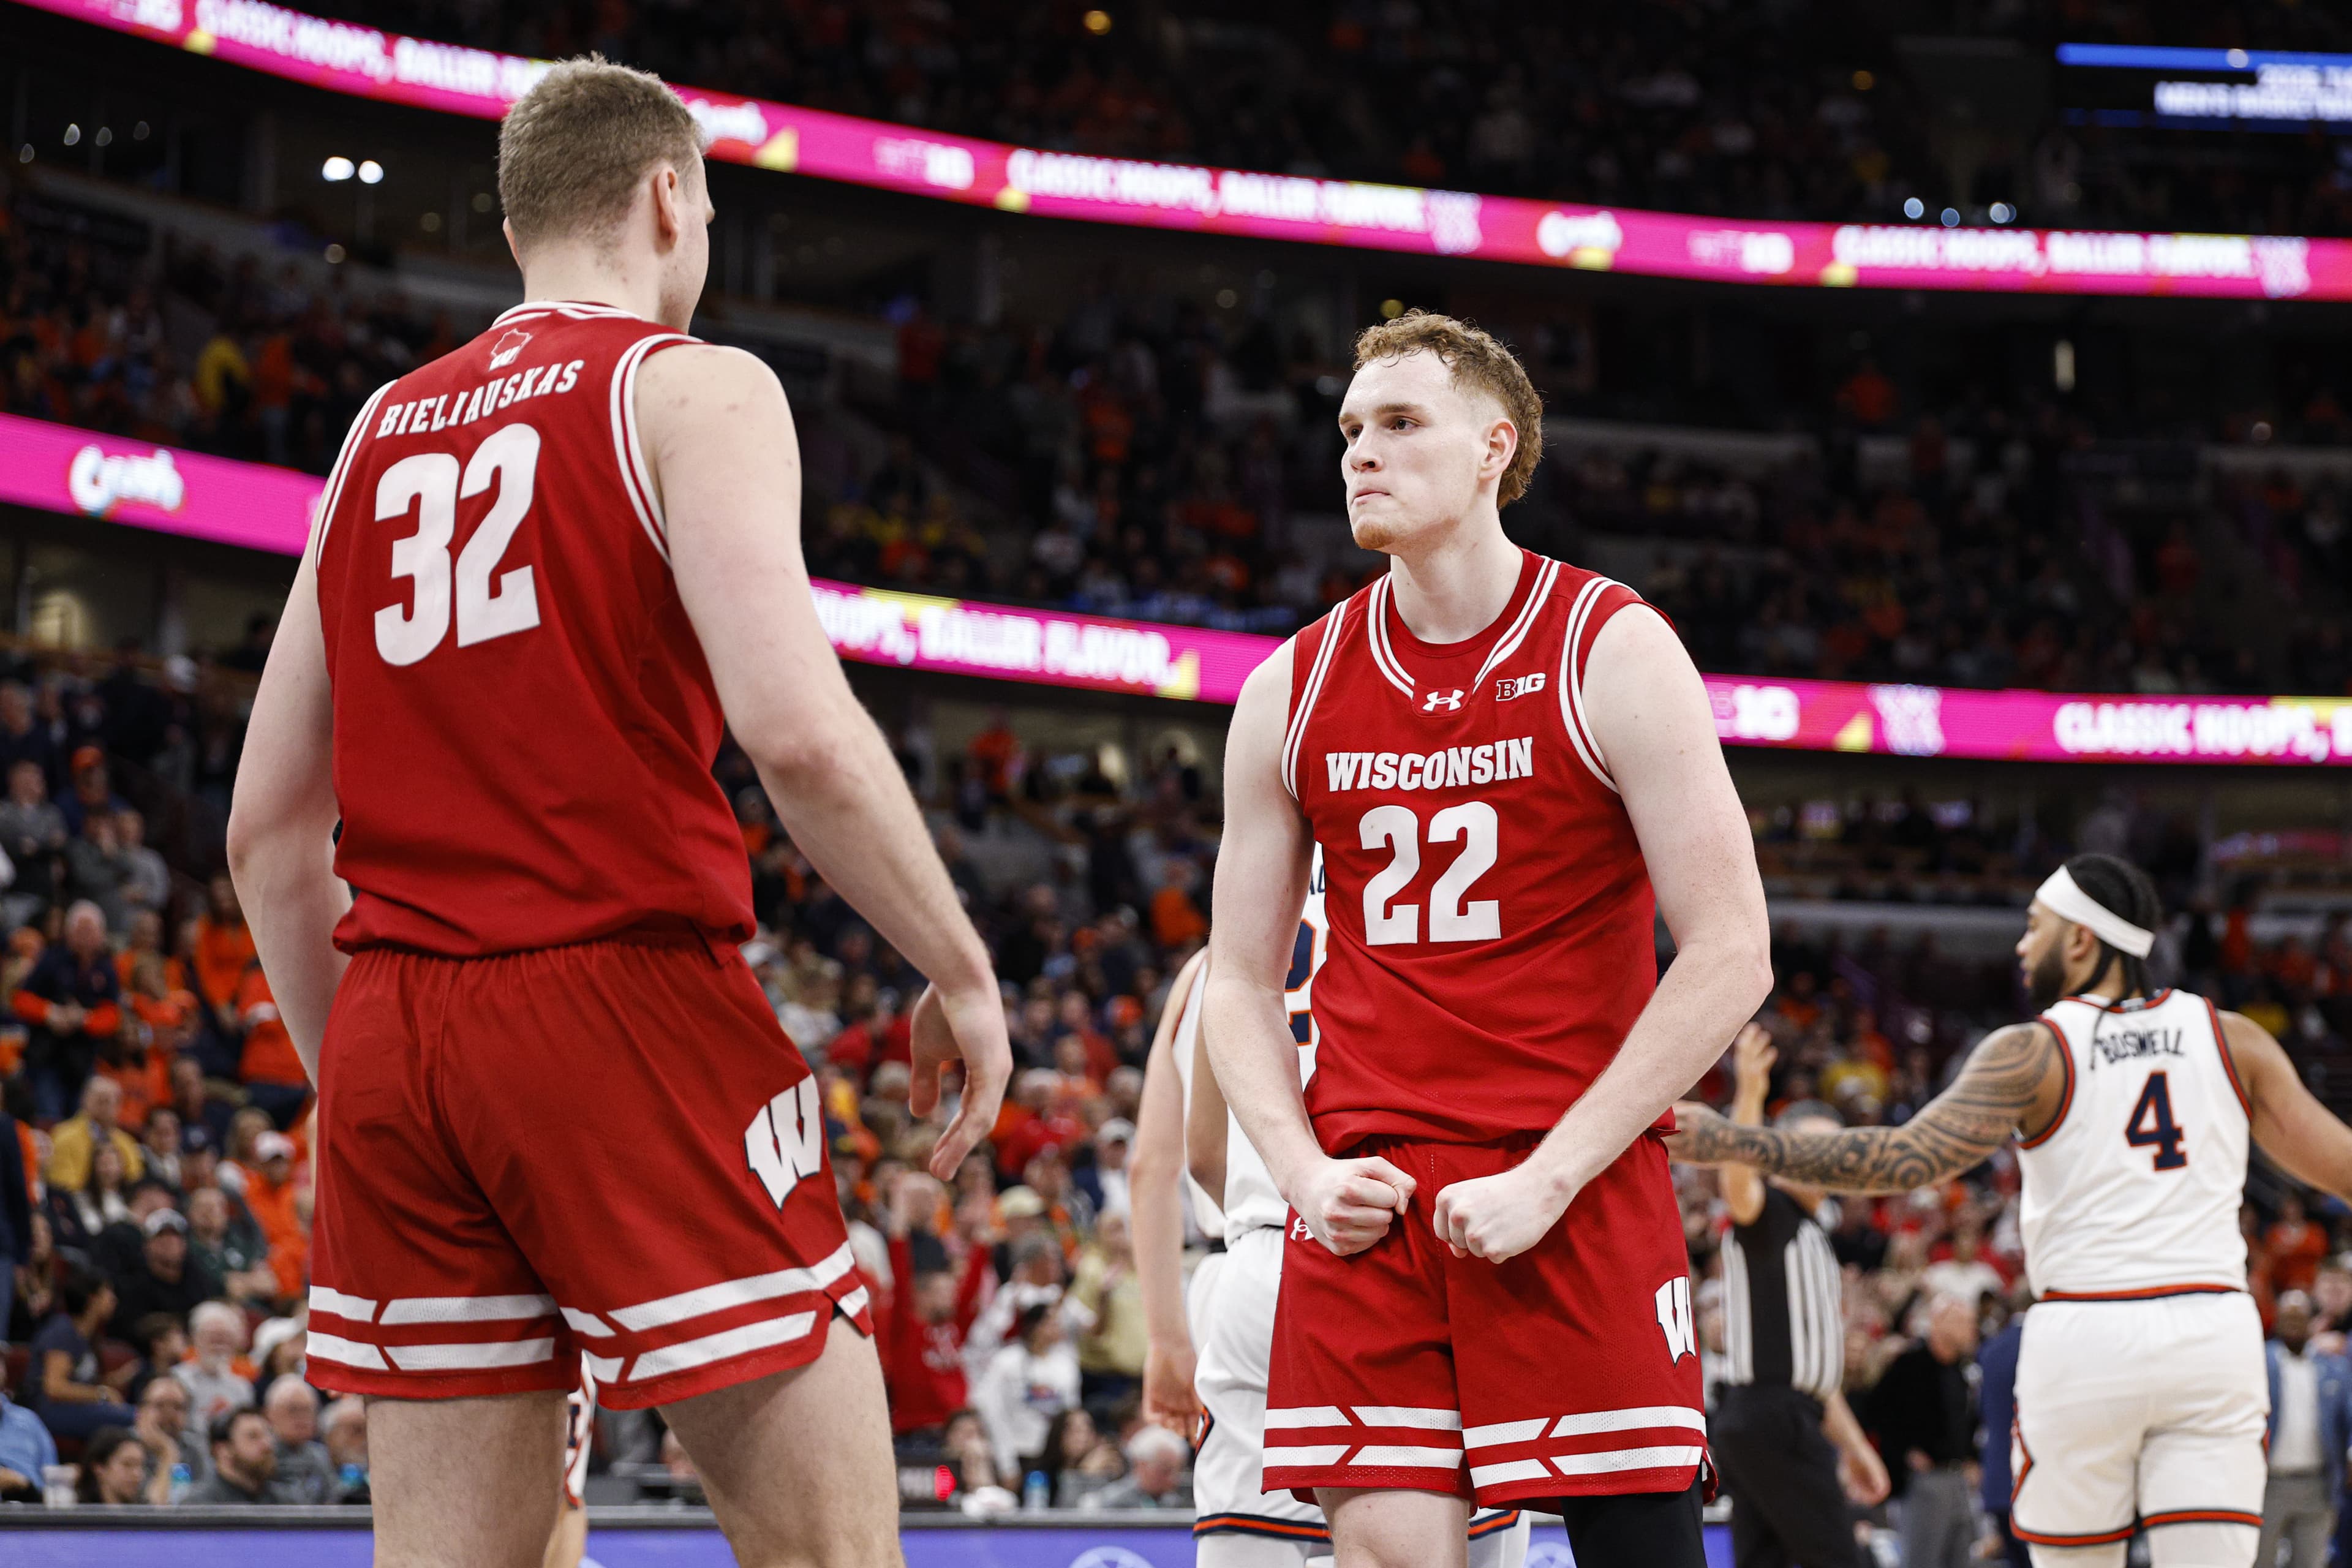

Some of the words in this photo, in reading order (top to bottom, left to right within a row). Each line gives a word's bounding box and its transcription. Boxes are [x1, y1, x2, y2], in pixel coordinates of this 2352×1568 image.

[376, 360, 585, 439] BIELIAUSKAS
[374, 423, 541, 666] 32
[1325, 736, 1533, 792] WISCONSIN
[1359, 801, 1502, 946] 22
[744, 1072, 822, 1213] W
[2125, 1068, 2188, 1172] 4
[1654, 1276, 1696, 1368] W
